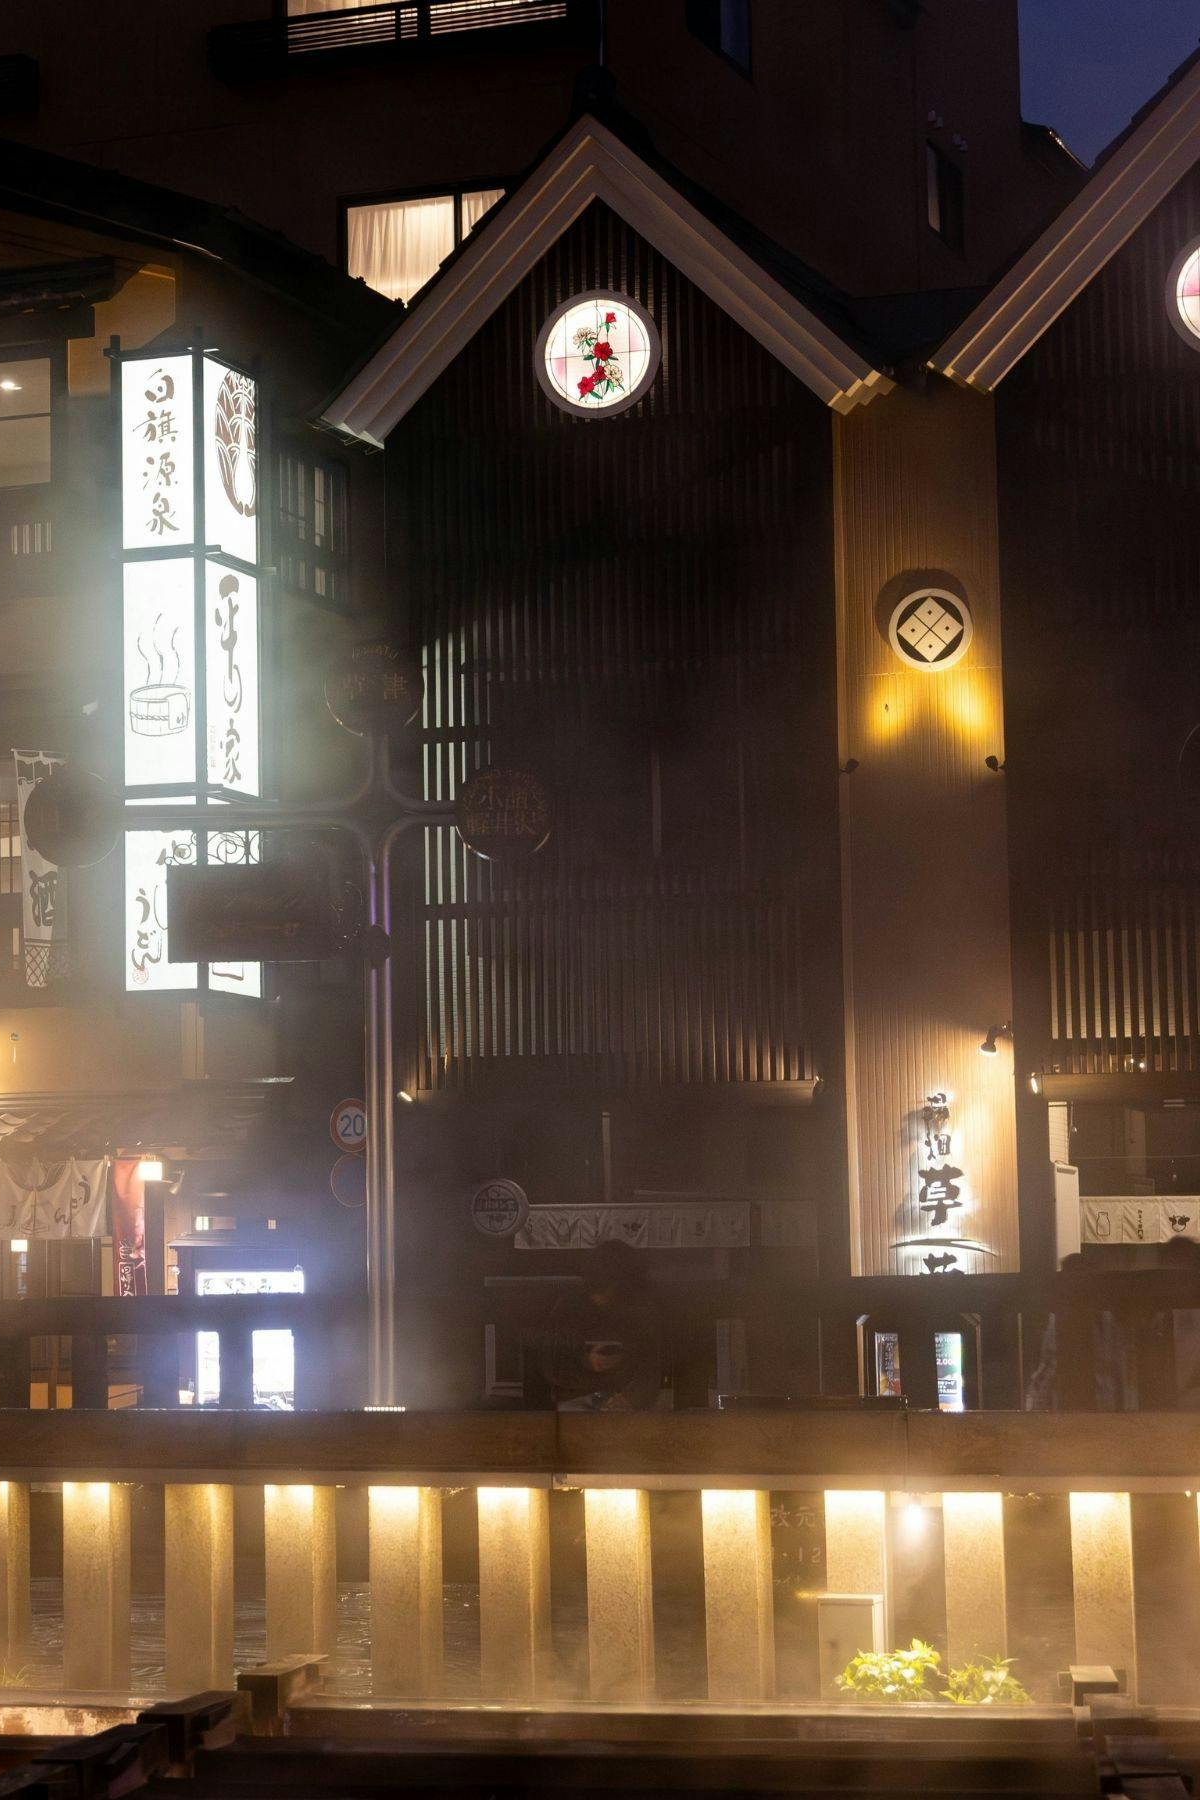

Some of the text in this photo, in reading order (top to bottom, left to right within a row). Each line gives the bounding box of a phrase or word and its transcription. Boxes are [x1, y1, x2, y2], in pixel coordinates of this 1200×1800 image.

[132, 368, 180, 536] 白旗源泉
[131, 887, 162, 970] うどん
[340, 1113, 365, 1138] 20
